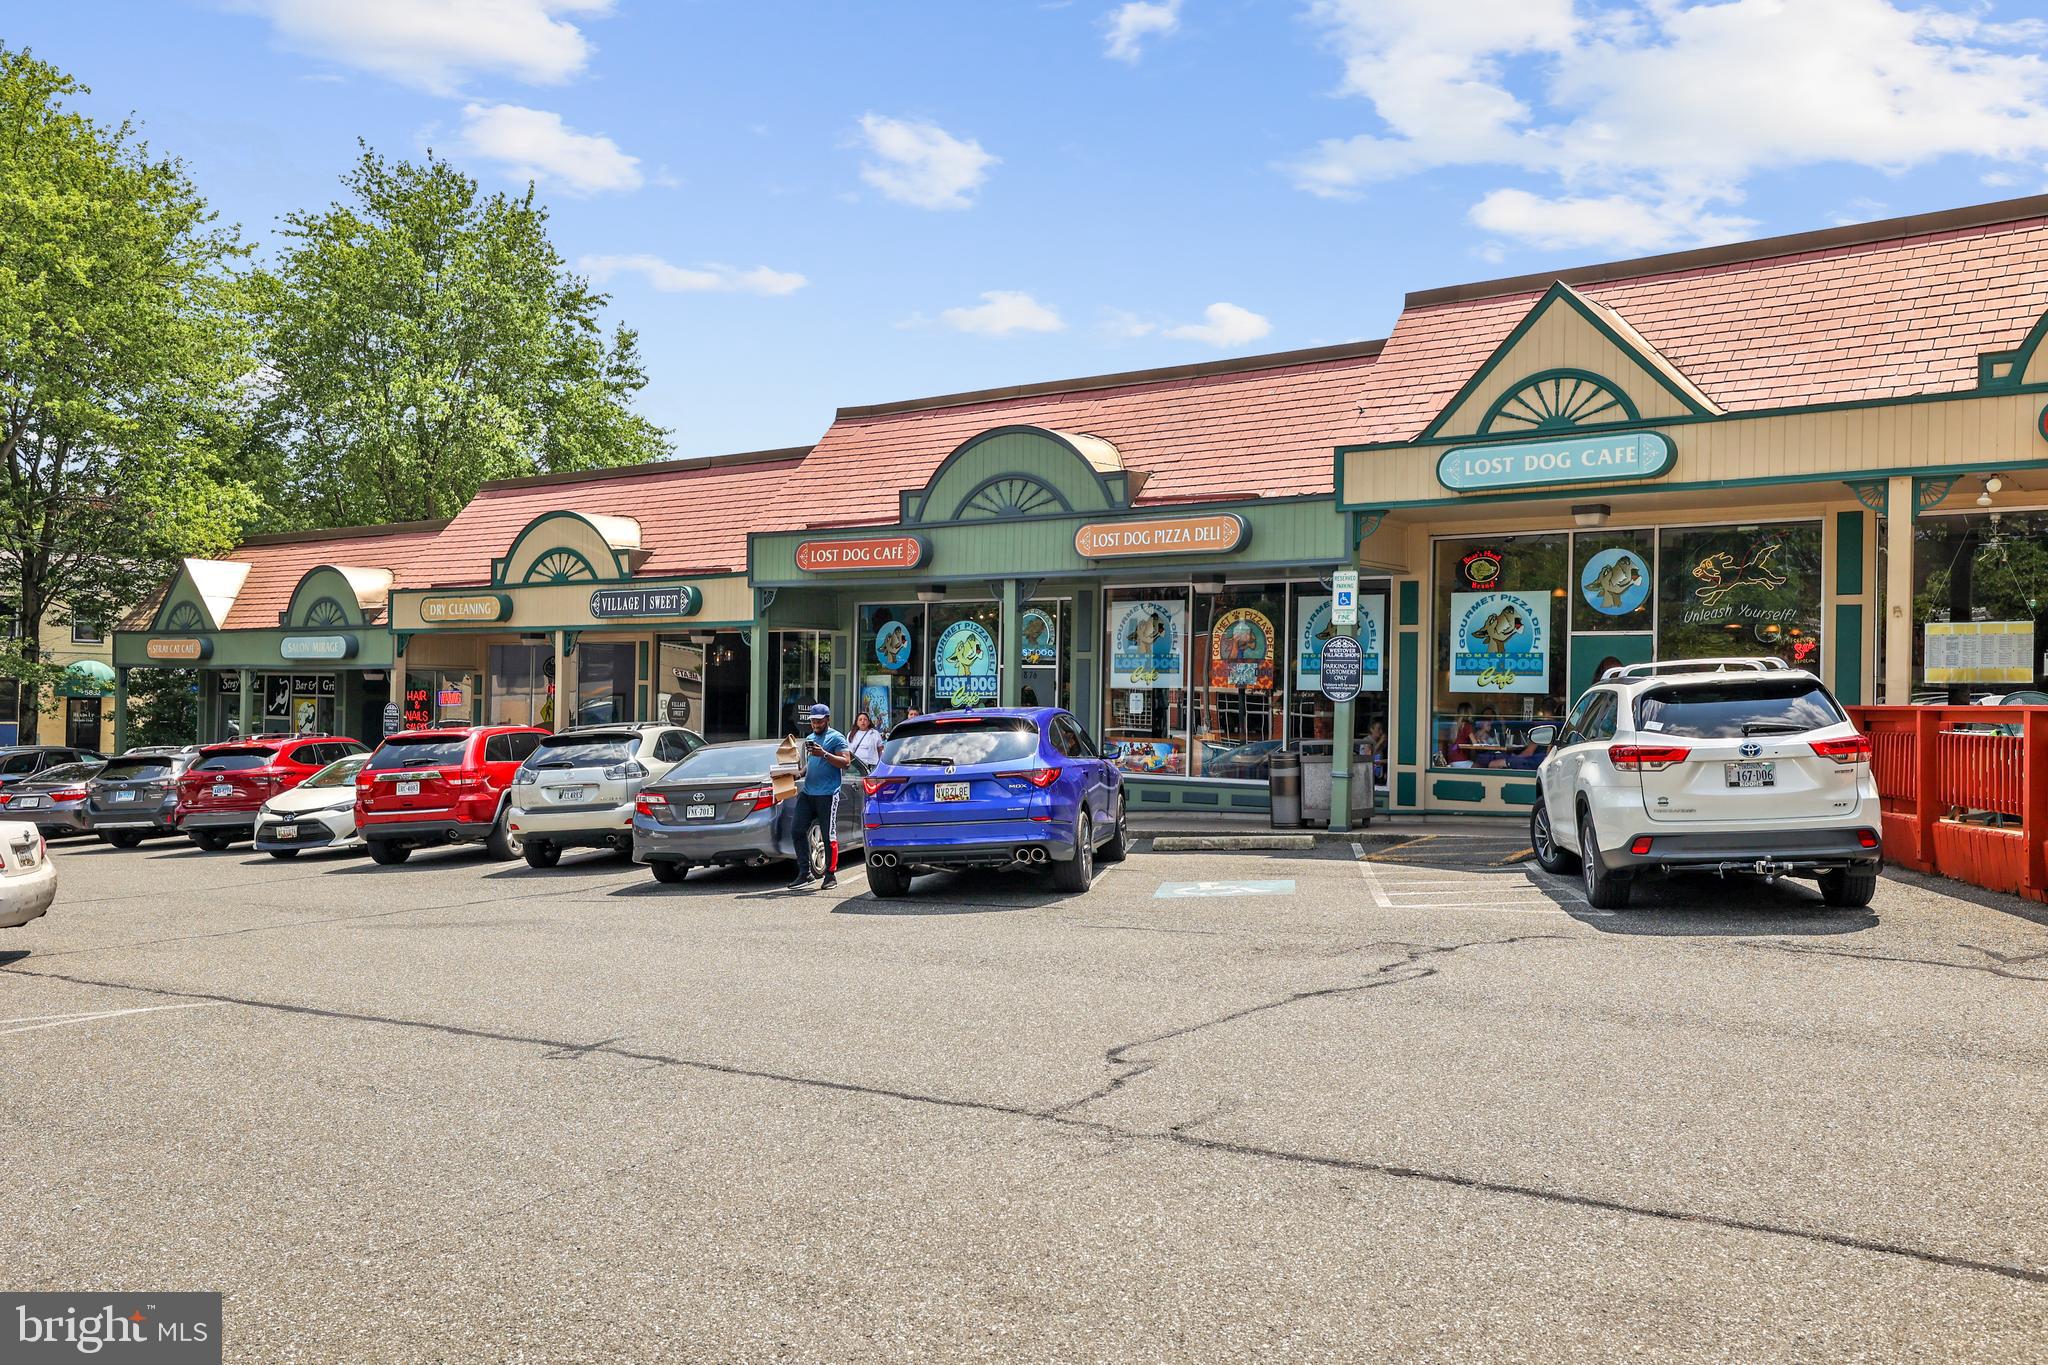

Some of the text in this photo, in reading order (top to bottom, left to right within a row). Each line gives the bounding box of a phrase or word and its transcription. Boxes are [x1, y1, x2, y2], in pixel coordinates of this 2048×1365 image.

[1464, 445, 1638, 476] LOST DOG CAFE
[1093, 525, 1221, 548] LOST DOG PIZZA DELI
[810, 543, 904, 563] LOST DOG CAFÉ
[429, 602, 491, 616] DRY CLEANING
[601, 594, 678, 611] VILLAGE SWEET
[1244, 611, 1267, 630] PIZZA
[1458, 594, 1541, 650] GOURMET PIZZA DELI
[1683, 604, 1797, 623] Unleash Yourself!
[1117, 603, 1145, 650] GOURMET
[1148, 602, 1173, 622] PIZZA
[1303, 600, 1333, 649] GOURME
[1367, 620, 1377, 650] DELI
[169, 645, 180, 654] CAT
[286, 642, 338, 653] SALON MIRAGE
[936, 624, 961, 672] GOURMET
[964, 622, 989, 643] PIZZA
[987, 643, 997, 673] DELI
[1456, 658, 1543, 671] LOST DOG
[222, 679, 240, 692] Stray
[295, 680, 308, 691] Bar
[322, 680, 334, 691] Gri
[937, 676, 967, 692] LOST
[970, 676, 997, 691] DOG
[406, 690, 427, 701] HAIR
[414, 700, 420, 709] &
[405, 710, 428, 722] NAILS
